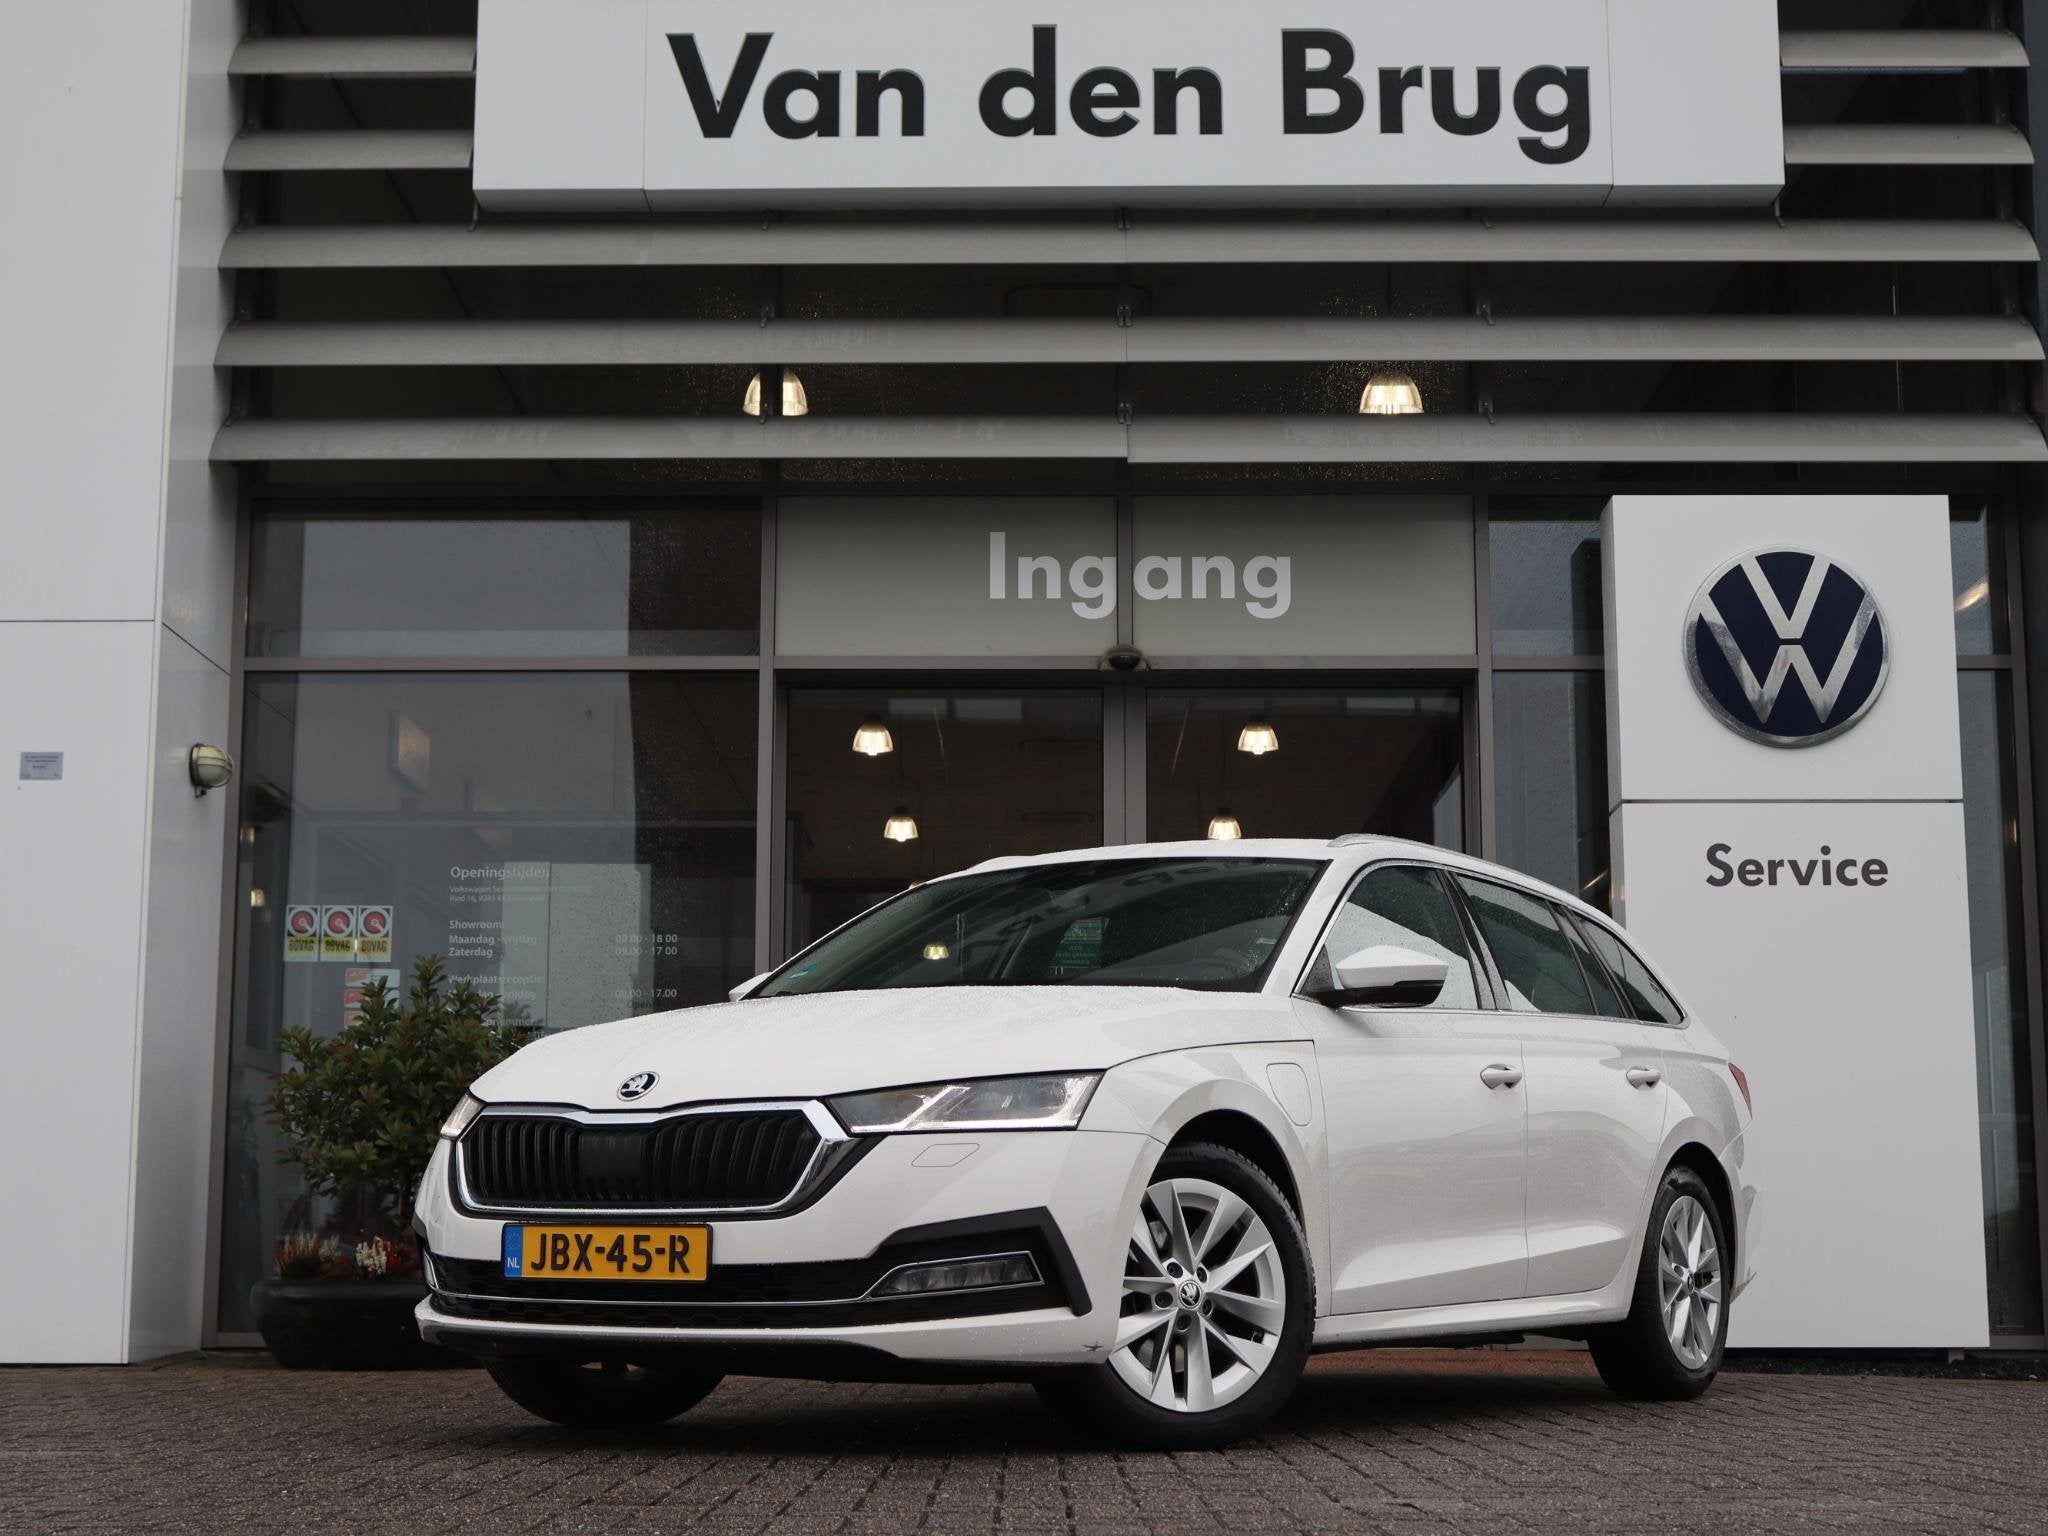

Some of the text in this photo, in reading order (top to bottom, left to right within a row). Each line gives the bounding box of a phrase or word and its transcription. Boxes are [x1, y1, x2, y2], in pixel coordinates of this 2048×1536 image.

[665, 24, 1592, 165] Van den Brug
[989, 531, 1292, 620] Ingang
[1706, 843, 1889, 888] Service
[449, 934, 495, 945] Maandag
[652, 934, 678, 942] 1800
[325, 940, 350, 952] BOVAG
[361, 940, 387, 953] BOVAG
[448, 946, 493, 957] Zaterdag
[652, 946, 678, 955] 1700
[507, 1232, 690, 1273] NL JBX-45-R
